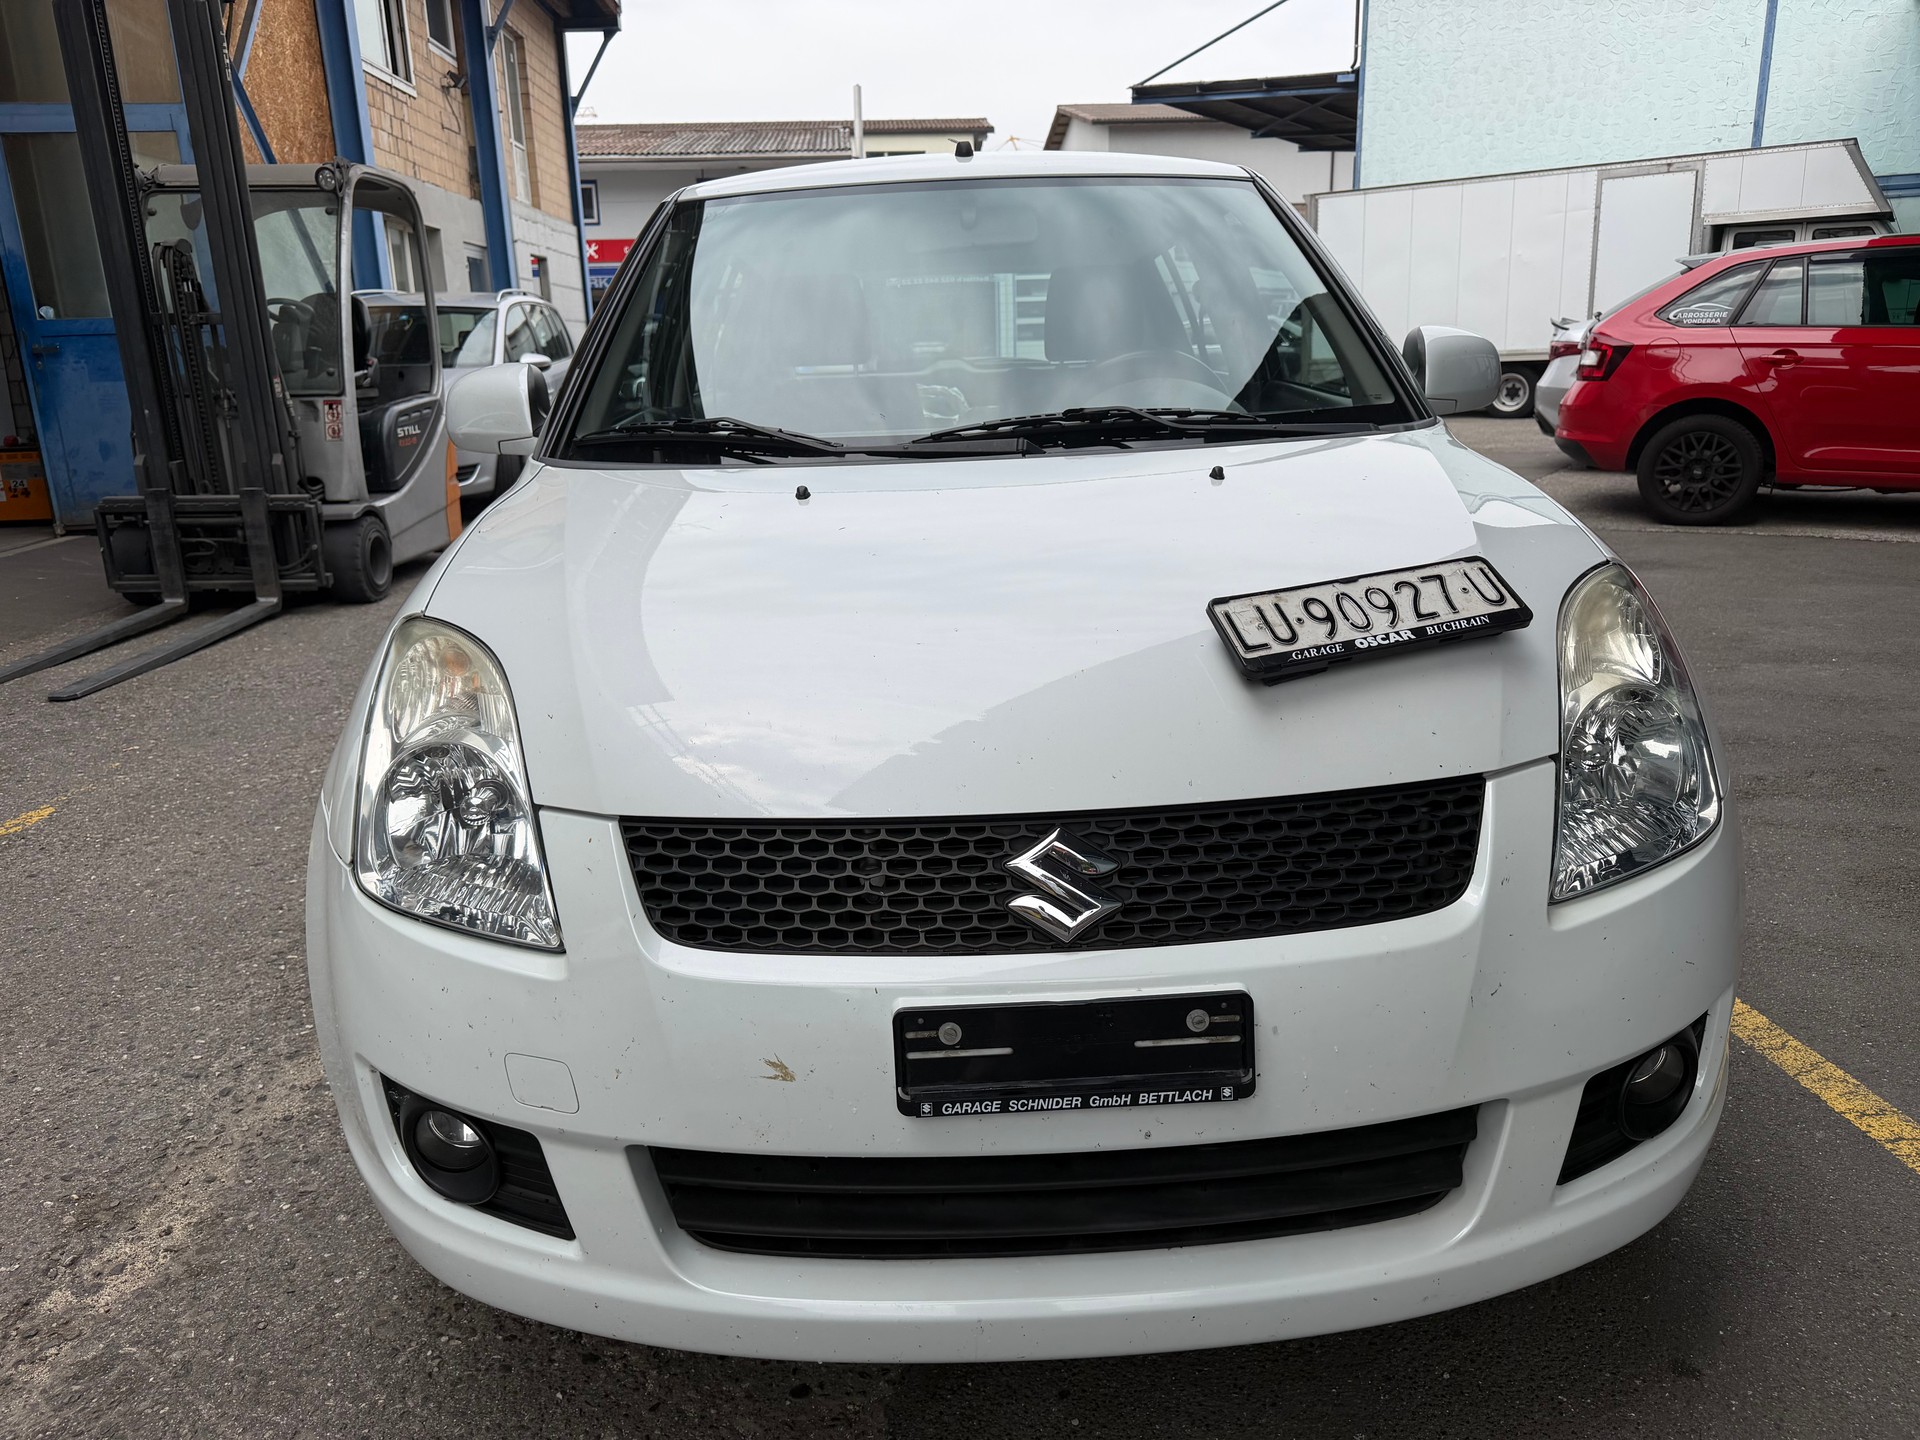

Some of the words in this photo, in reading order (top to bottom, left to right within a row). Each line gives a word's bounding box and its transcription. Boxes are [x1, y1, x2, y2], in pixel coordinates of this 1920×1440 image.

[1669, 307, 1728, 320] CARROSSERIE
[397, 425, 421, 437] STILL
[12, 480, 25, 488] 24
[1291, 643, 1345, 661] GARAGE
[1354, 630, 1416, 650] OSCAR
[1426, 614, 1490, 635] BUCHRAIN
[942, 1100, 1001, 1115] GARAGE
[1008, 1096, 1082, 1112] SCHNIDER
[1089, 1093, 1131, 1107] GmbH
[1138, 1089, 1213, 1105] BETTLACH
